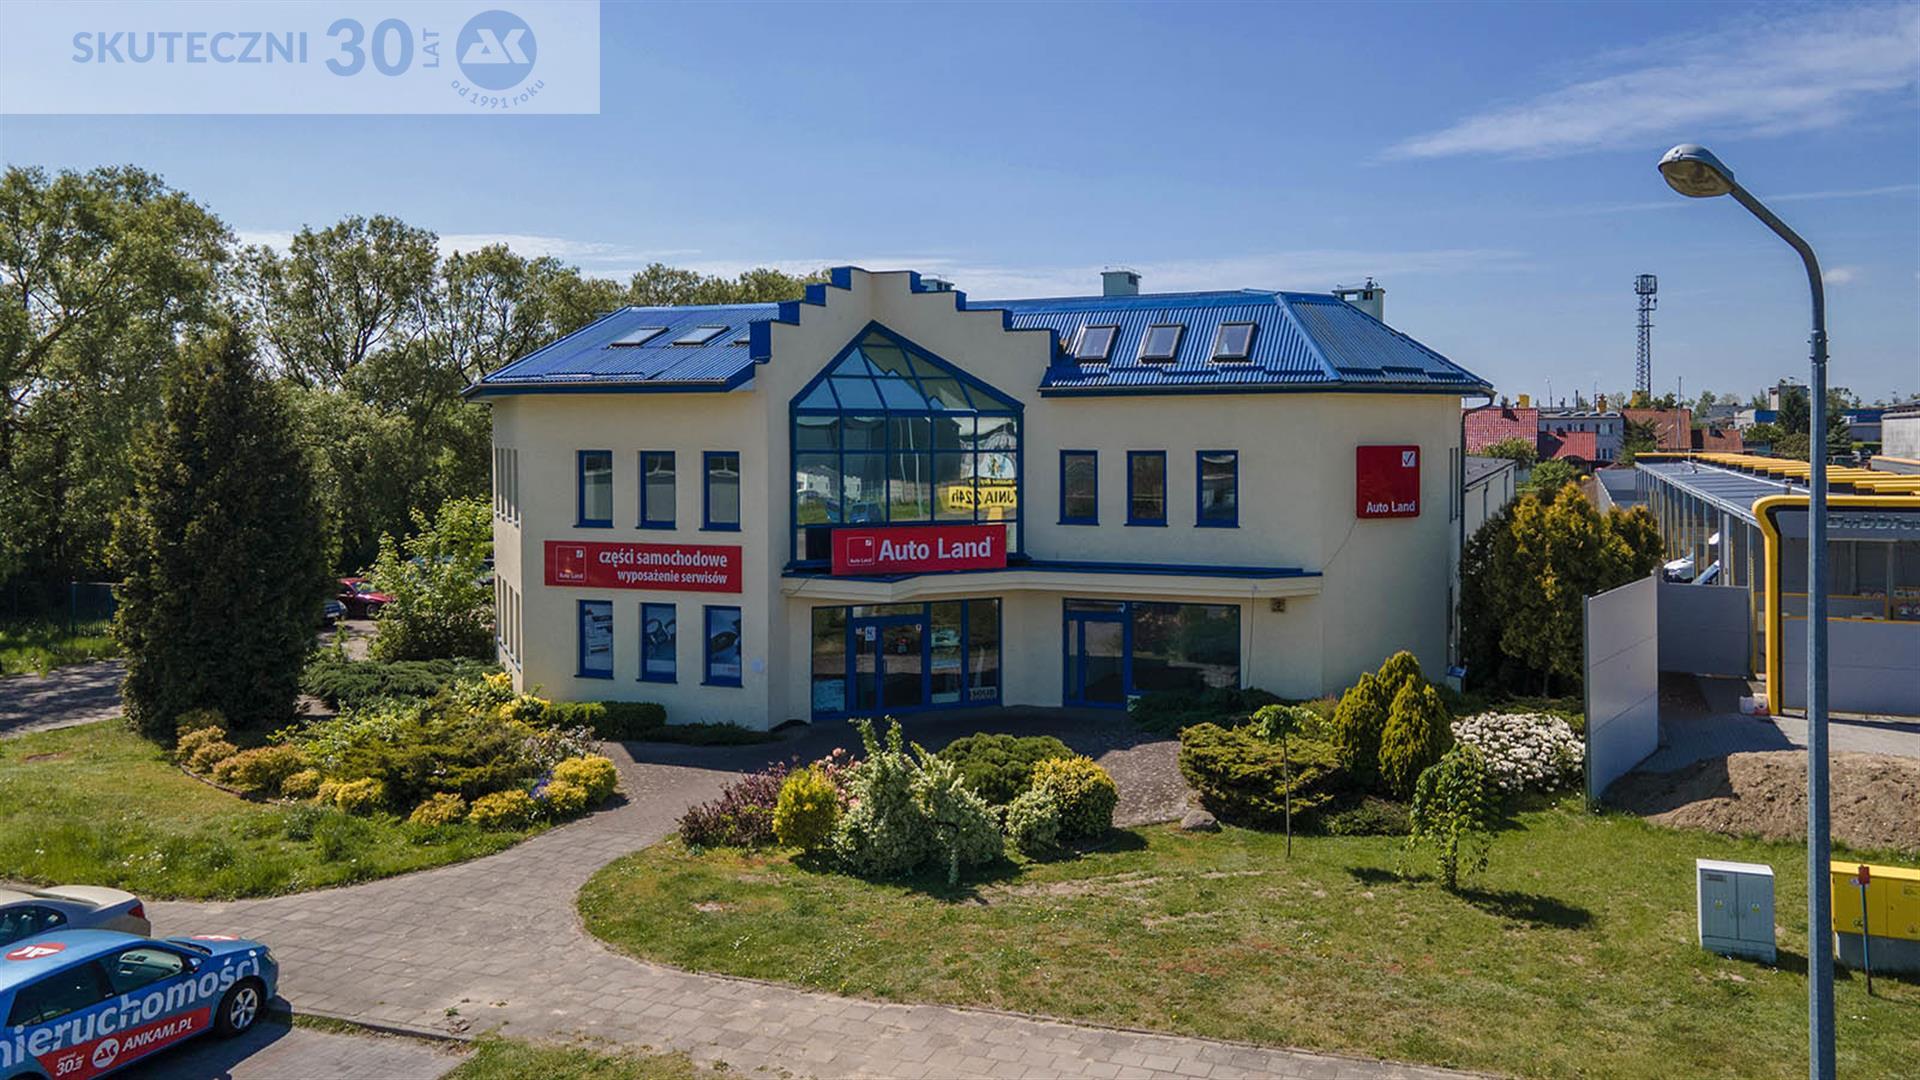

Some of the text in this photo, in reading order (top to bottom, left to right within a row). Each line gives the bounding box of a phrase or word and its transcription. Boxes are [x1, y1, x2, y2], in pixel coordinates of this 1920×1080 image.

[1366, 500, 1416, 513] Auto Land
[599, 548, 728, 567] części samochodowe
[879, 536, 991, 561] Auto Land
[617, 569, 728, 584] wyposażenie serwisów
[122, 1017, 193, 1052] ANKAM.PL
